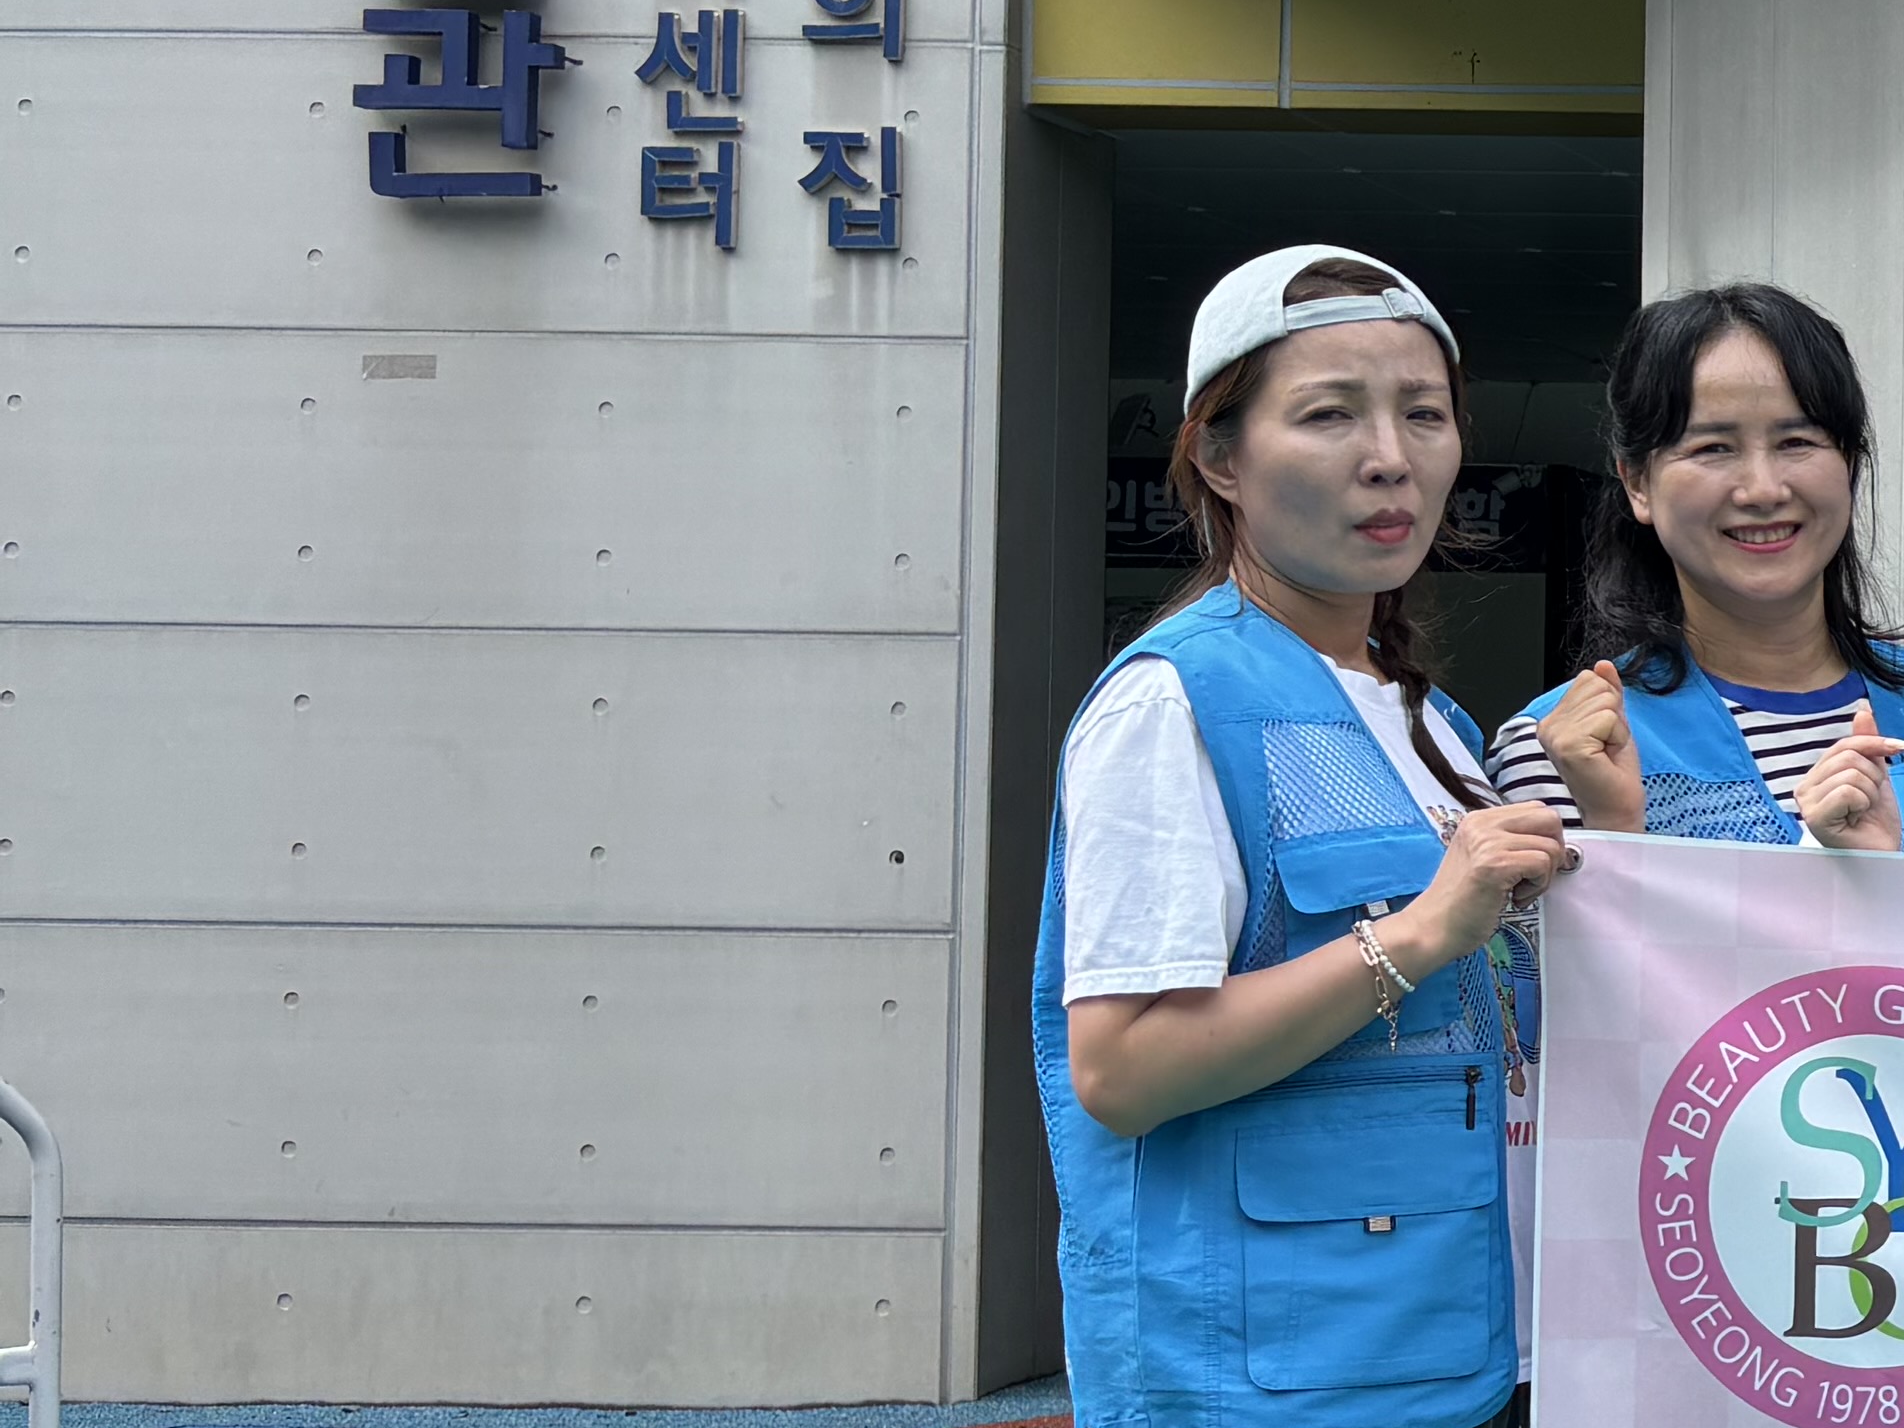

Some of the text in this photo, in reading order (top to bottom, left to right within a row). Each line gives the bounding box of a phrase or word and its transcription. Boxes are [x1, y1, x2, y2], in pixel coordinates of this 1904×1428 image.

[1667, 983, 1849, 1140] BEAUTY
[1654, 1191, 1805, 1409] SEOYEONG
[1816, 1381, 1901, 1425] 1978
